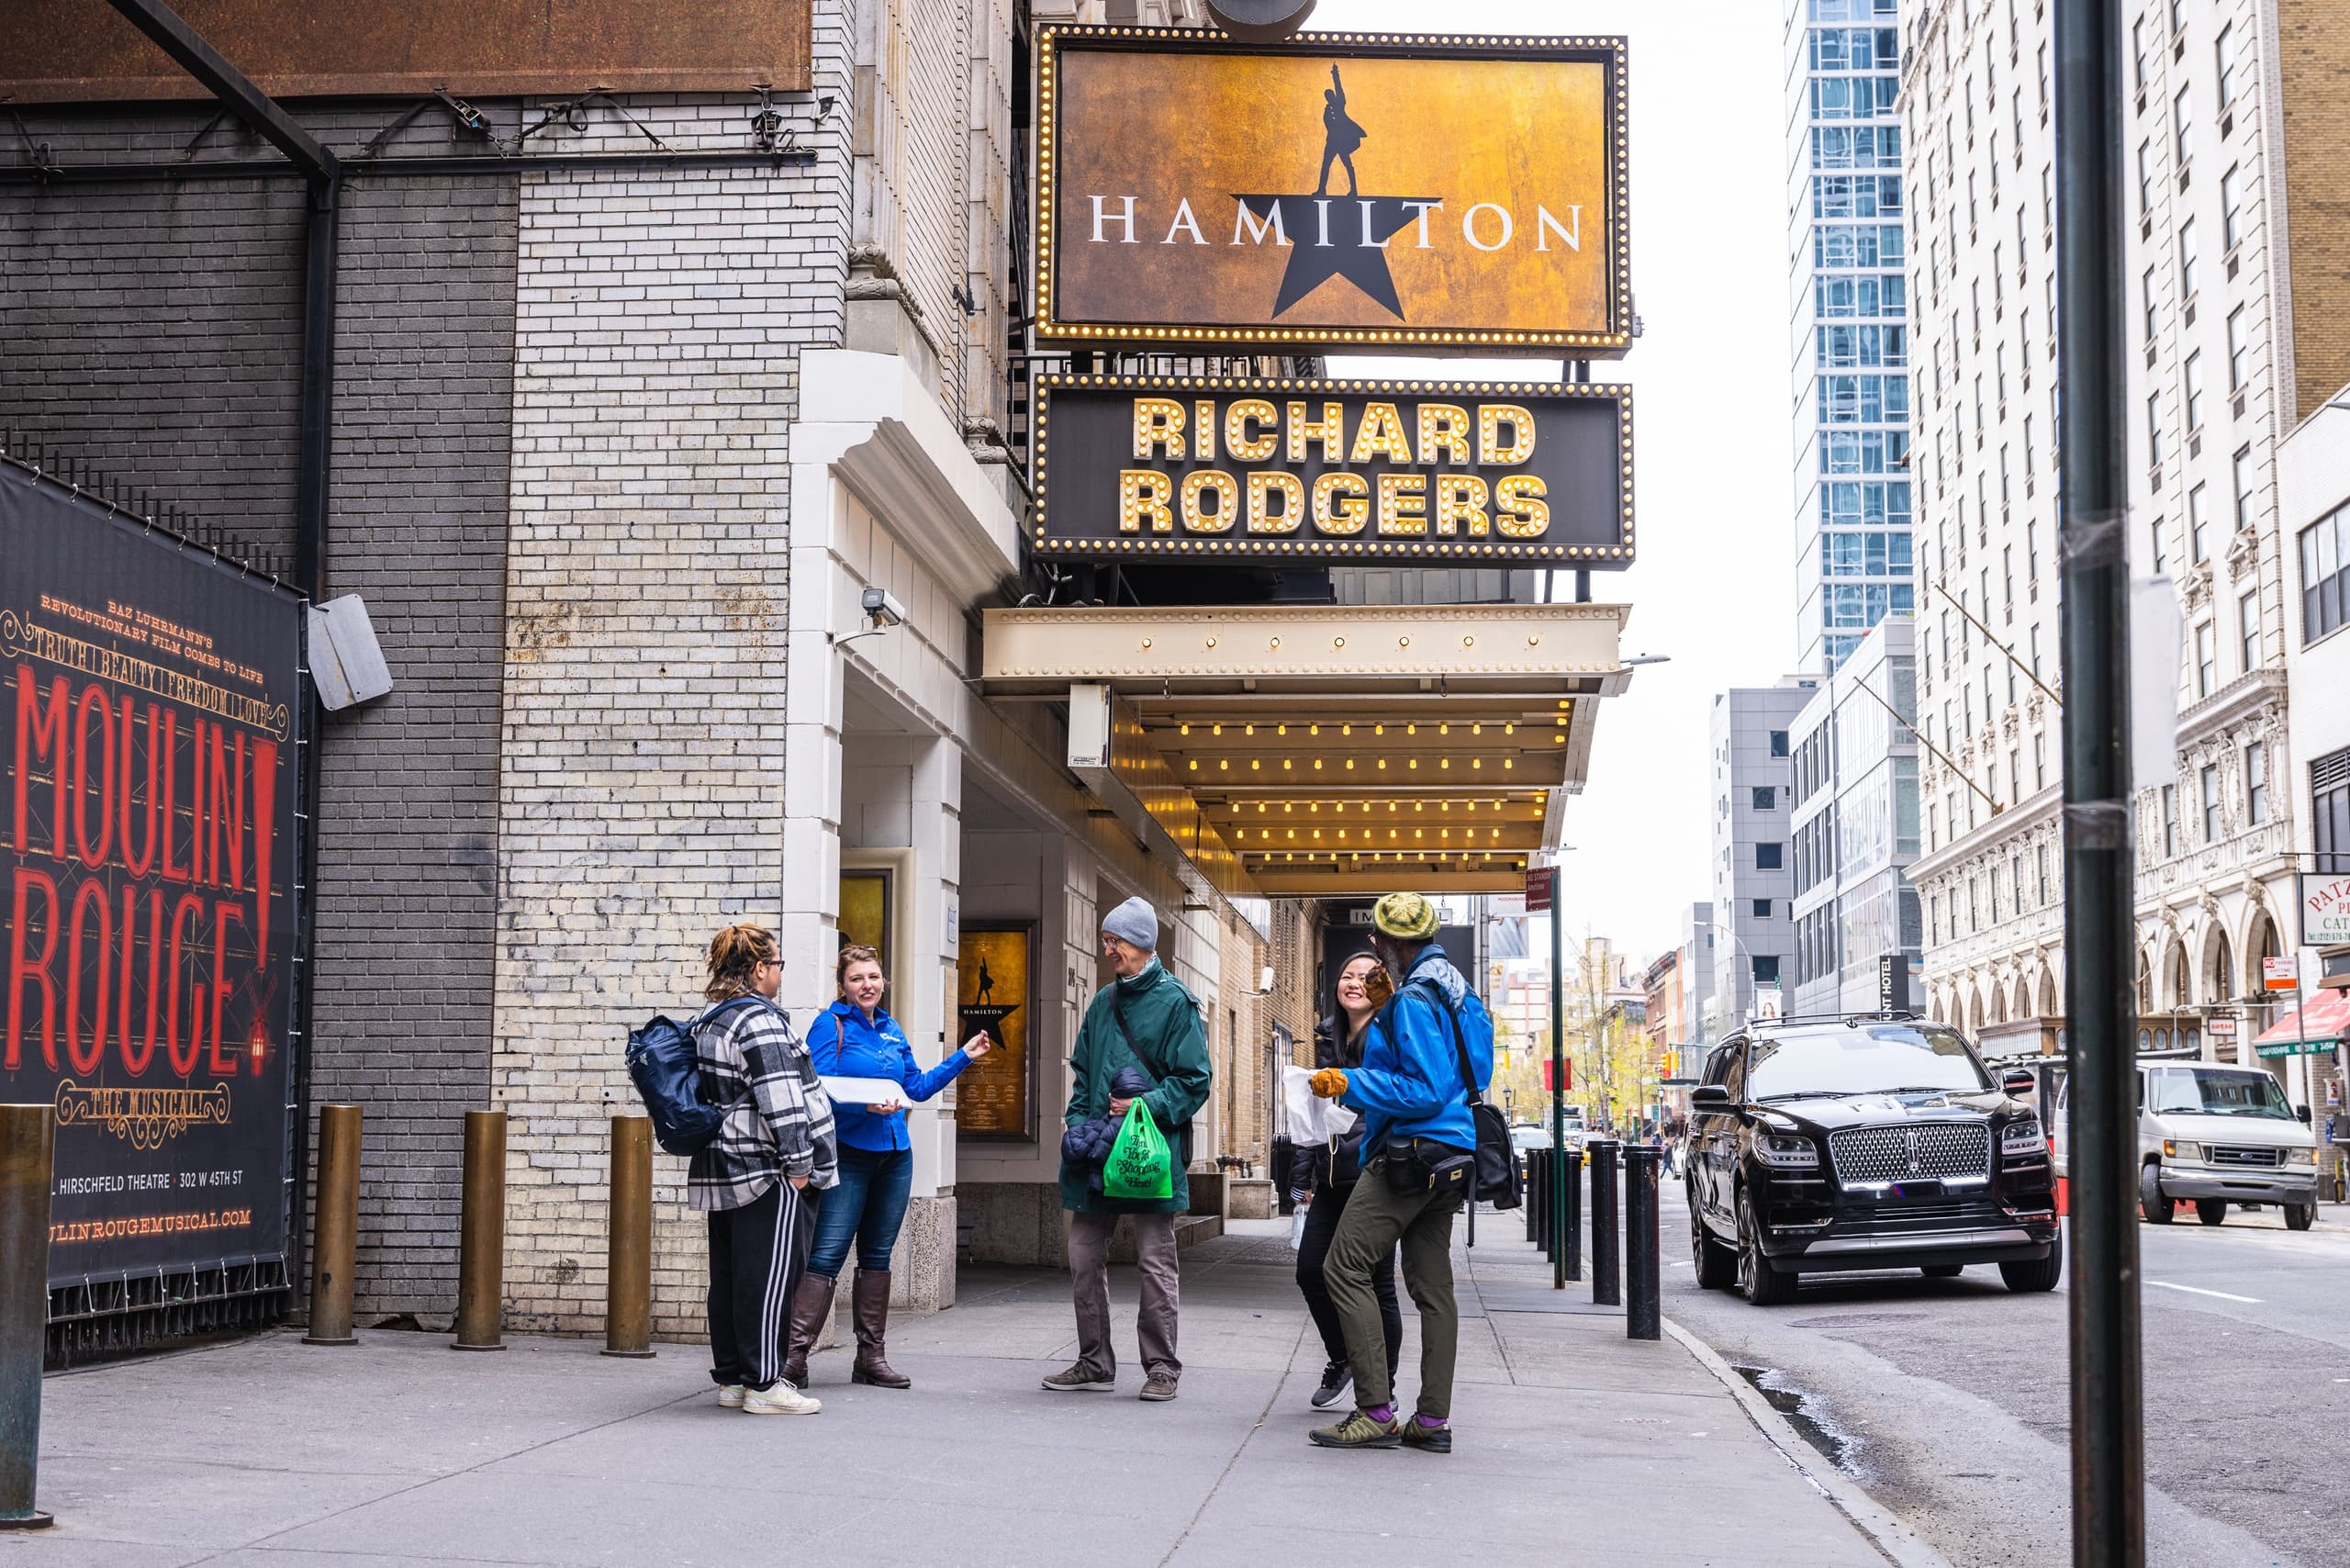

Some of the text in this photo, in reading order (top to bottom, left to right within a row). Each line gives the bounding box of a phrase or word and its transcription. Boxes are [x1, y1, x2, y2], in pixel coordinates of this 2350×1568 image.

[1086, 195, 1583, 252] HAMILTON
[1133, 397, 1536, 465] RICHARD
[1119, 468, 1550, 538] RODGERS
[40, 595, 263, 684] REVOLUTIONARY FILM COMES TO LIFE
[108, 600, 213, 648] BAZ LUHRMANN'S
[35, 625, 267, 728] TRUTH BEAUTY FREEDOM LOVE
[14, 664, 245, 894] MOULIN
[1534, 871, 1551, 881] STANDIN
[4, 867, 244, 1078] ROUGE
[1882, 958, 1891, 994] HOTEL
[91, 1090, 204, 1117] THE MUSICAL!
[60, 1170, 243, 1195] HIRSCHFELD THEATRE 302 W 45TH ST
